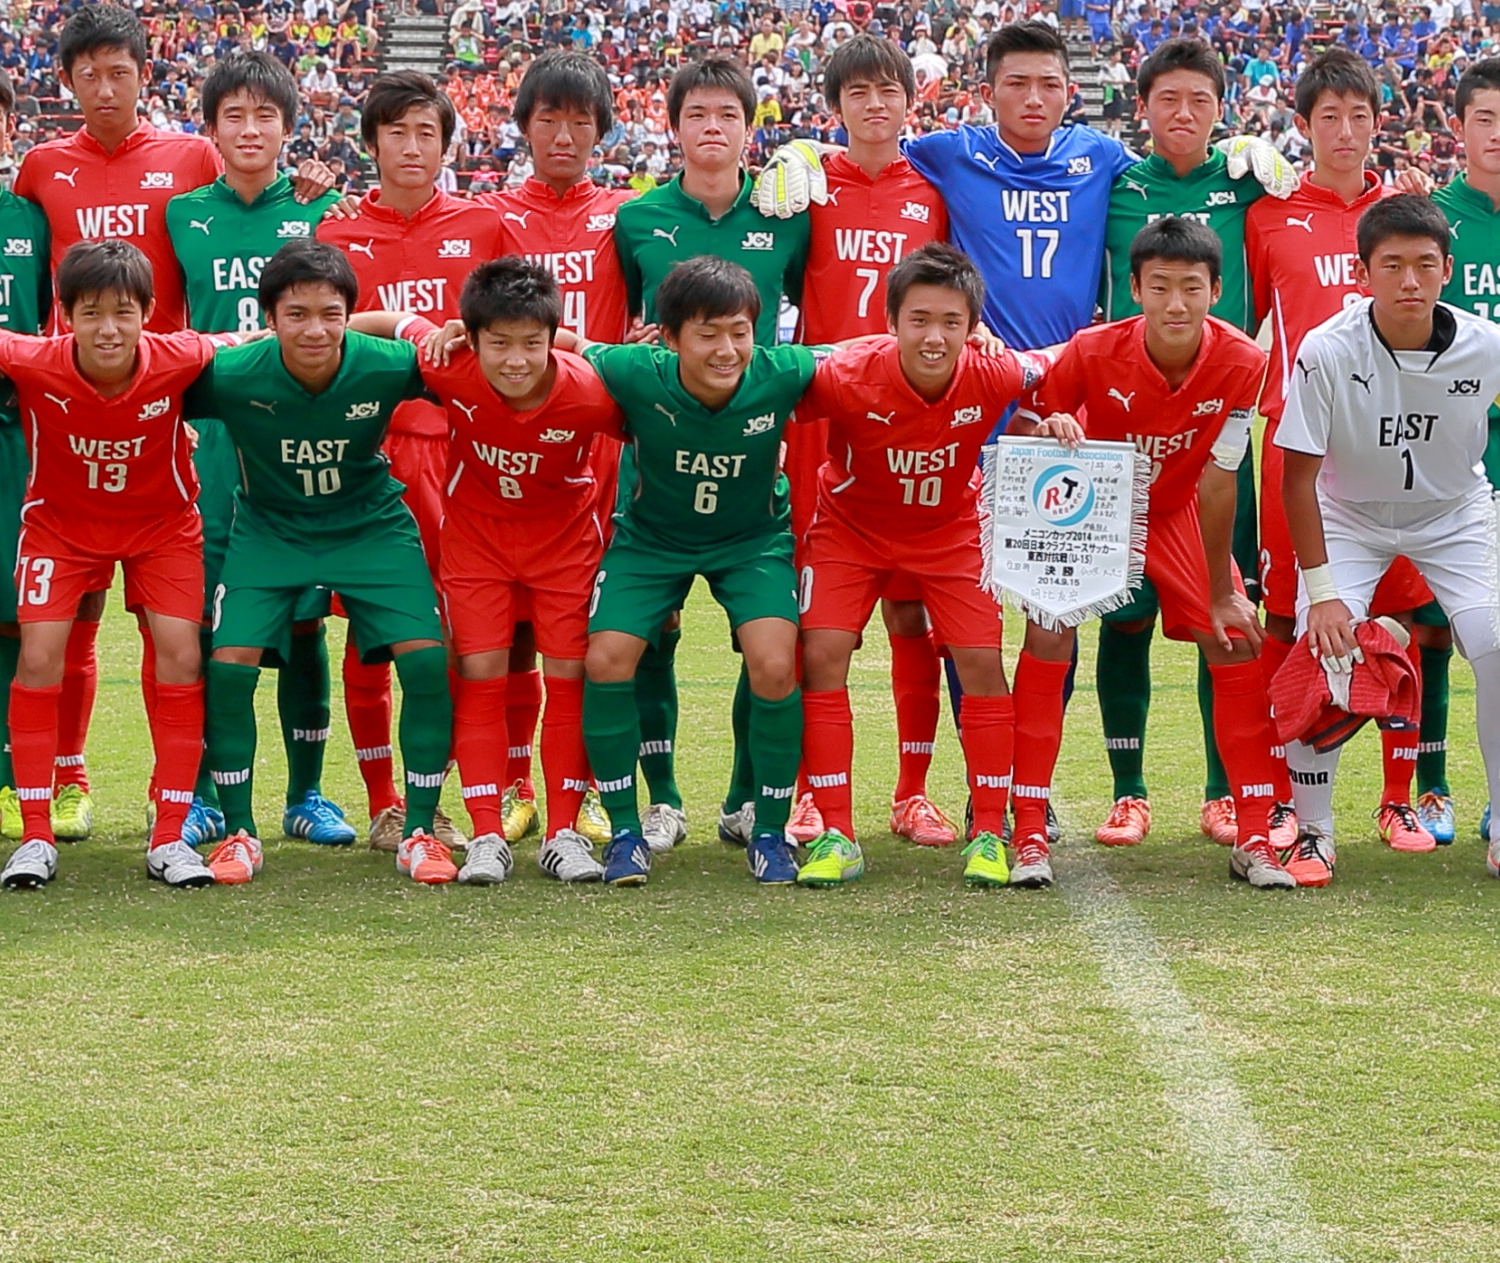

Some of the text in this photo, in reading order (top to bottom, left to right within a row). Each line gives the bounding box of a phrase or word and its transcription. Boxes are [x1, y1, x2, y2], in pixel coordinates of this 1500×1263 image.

[1066, 156, 1093, 175] JCY
[140, 171, 175, 189] JCY
[1001, 190, 1071, 223] WEST
[1204, 190, 1237, 208] JCY
[75, 204, 149, 239] WEST
[900, 201, 931, 221] JCY
[277, 221, 311, 240] JCY
[585, 213, 616, 232] JCY
[3, 238, 34, 257] JCY
[438, 239, 471, 258] JCY
[741, 231, 774, 250] JCY
[835, 228, 906, 265] WEST
[1014, 228, 1060, 280] 17
[212, 256, 270, 291] EAS
[376, 278, 447, 314] WEST
[854, 268, 879, 318] 7
[1447, 379, 1480, 397] JCY
[137, 396, 170, 420] JCY
[345, 401, 380, 420] JCY
[951, 405, 982, 428] JCY
[1192, 398, 1224, 417] JCY
[743, 412, 775, 435] JCY
[1379, 414, 1439, 448] EAST
[538, 428, 575, 444] JCY
[68, 435, 147, 461] WEST
[281, 439, 350, 464] EAST
[471, 440, 543, 475] WEST
[887, 443, 960, 474] WEST
[1009, 446, 1123, 461] Japan Football Association
[675, 451, 747, 478] EAST
[1400, 449, 1414, 490] 1
[84, 461, 128, 493] 13
[295, 467, 342, 497] 10
[499, 476, 523, 500] 8
[694, 480, 718, 515] 6
[898, 476, 946, 508] 10
[1023, 528, 1092, 542] メニコンカップ2014
[1038, 576, 1080, 586] 2014.9.15
[902, 741, 934, 754] PUM
[462, 783, 498, 798] UMA
[594, 774, 632, 792] UMA
[976, 774, 1010, 789] PUM
[1241, 783, 1274, 798] PUM
[161, 788, 193, 804] PUM
